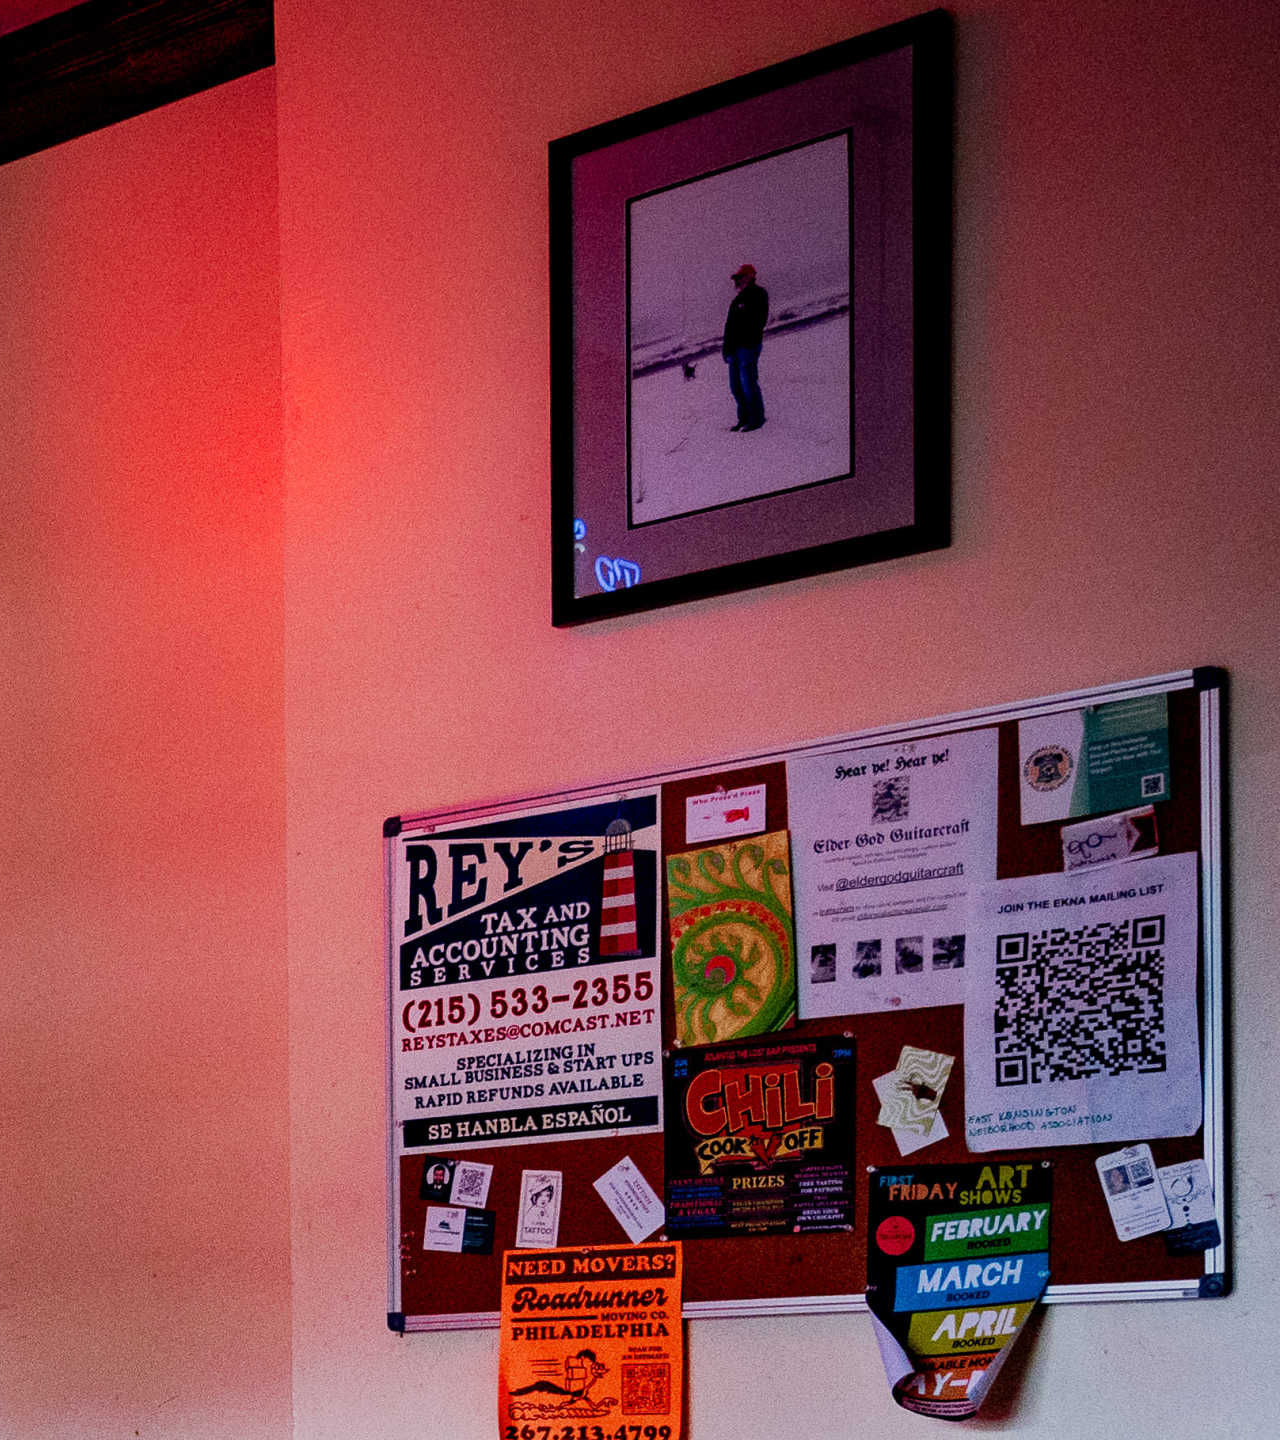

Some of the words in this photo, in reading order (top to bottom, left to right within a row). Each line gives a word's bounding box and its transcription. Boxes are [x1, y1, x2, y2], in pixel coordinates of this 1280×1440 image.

[834, 766, 867, 781] Hear
[895, 756, 927, 771] Hear
[813, 839, 850, 854] Elder
[855, 832, 885, 848] God
[890, 819, 970, 843] Guitarcraft
[404, 839, 595, 938] REY'S
[835, 863, 964, 891] @eldergodguitarcraft
[998, 903, 1024, 914] JOIN
[1028, 900, 1050, 911] THE
[1053, 897, 1086, 908] EKNA
[1089, 888, 1137, 904] MAILING
[1139, 884, 1164, 896] LIST
[480, 906, 539, 936] TAX
[543, 901, 591, 926] AND
[409, 925, 591, 969] ACCOUNTING
[402, 992, 481, 1034] (215)
[490, 971, 654, 1019] 533-2355
[401, 1009, 656, 1053] REYSTAXES@COMCAST.NET
[404, 1074, 461, 1091] SMALL
[465, 1064, 544, 1085] BUSINESS
[547, 1061, 560, 1075] &
[563, 1055, 617, 1074] START
[623, 1051, 655, 1068] UPS
[456, 1046, 573, 1071] SPECIALIZING
[577, 1043, 596, 1057] IN
[414, 1091, 463, 1110] RAPID
[466, 1082, 545, 1104] REFUNDS
[549, 1073, 645, 1098] AVAILABLE
[427, 1123, 453, 1142] SE
[455, 1114, 539, 1138] HANBLA
[543, 1104, 633, 1132] ESPAÑOL
[968, 1113, 994, 1124] EAST
[698, 1137, 747, 1160] COOK
[784, 1131, 823, 1150] OFF
[732, 1175, 785, 1190] PRIZES
[880, 1174, 913, 1187] FIRST
[976, 1164, 1033, 1190] ART
[889, 1181, 959, 1201] FRIDAY
[959, 1189, 1023, 1206] SHOWS
[930, 1209, 1048, 1242] FEBRUARY
[967, 1238, 1011, 1250] BOOKED
[507, 1259, 566, 1277] NEED
[573, 1254, 675, 1275] MOVERS?
[917, 1258, 1024, 1294] MARCH
[511, 1285, 669, 1313] Roadrunner
[946, 1291, 990, 1303] BOOKED
[601, 1312, 647, 1322] MOVING
[650, 1311, 670, 1320] CO.
[931, 1307, 1018, 1342] APRIL
[511, 1323, 670, 1341] PHILADELPHIA
[952, 1337, 996, 1349] BOOKED
